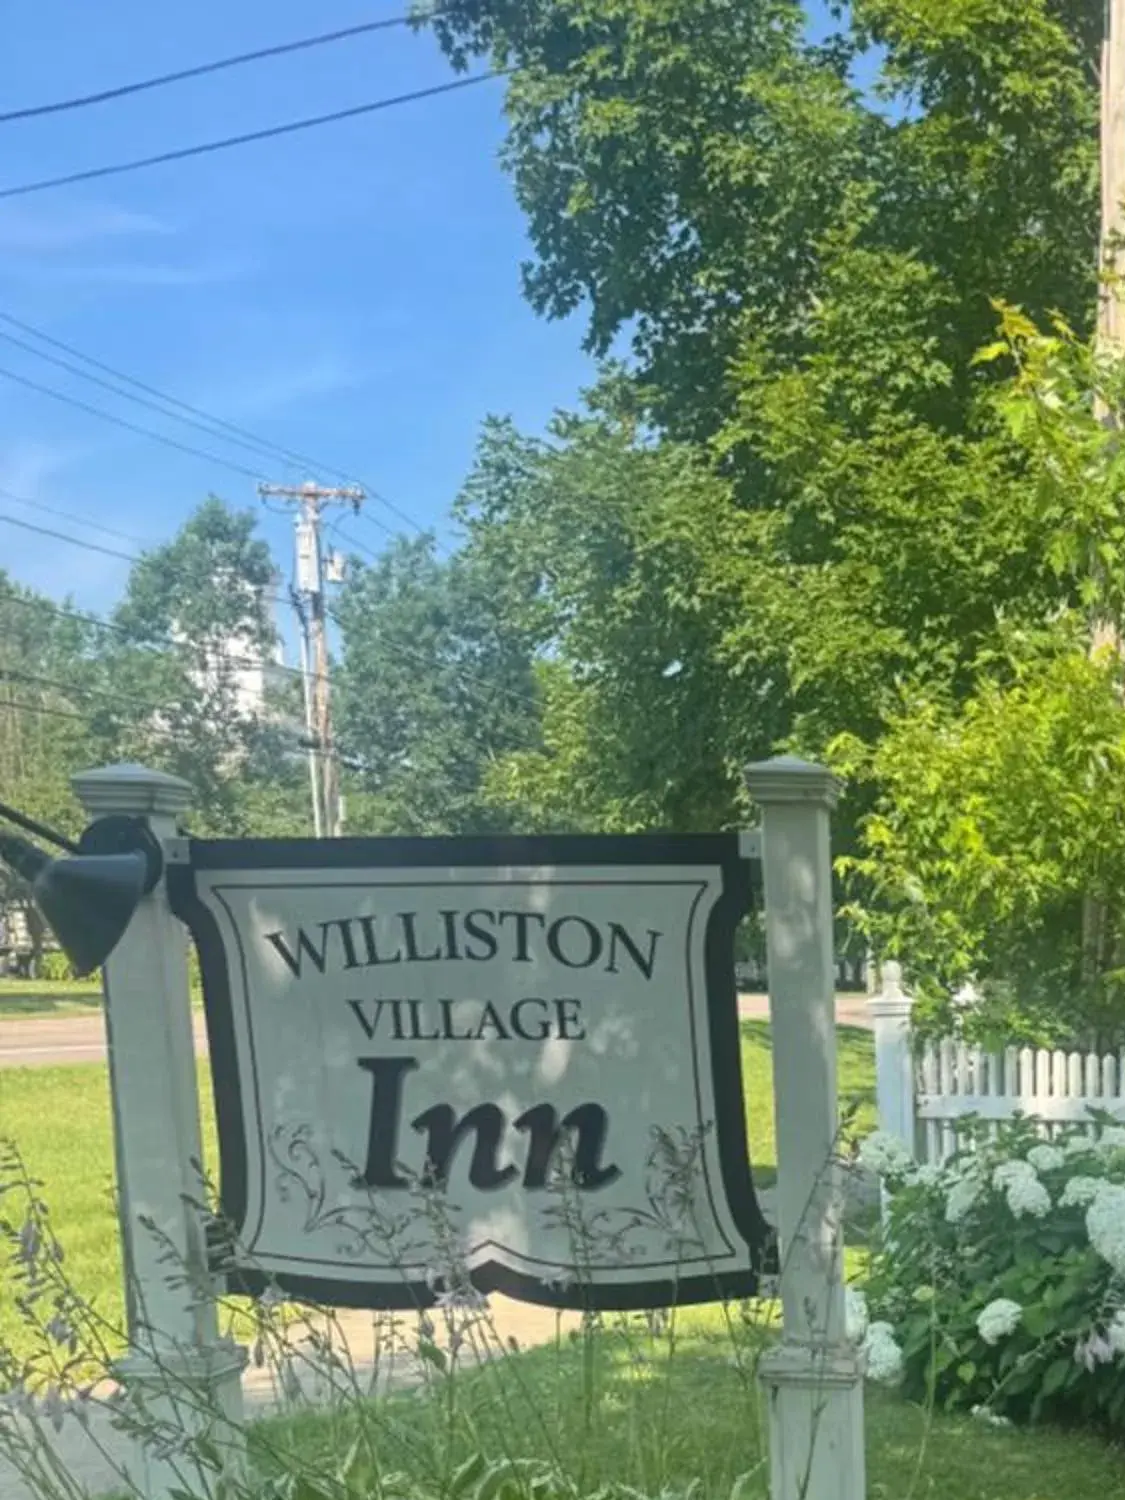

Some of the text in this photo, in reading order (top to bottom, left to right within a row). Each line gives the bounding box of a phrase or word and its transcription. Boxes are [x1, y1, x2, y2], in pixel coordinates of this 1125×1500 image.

[266, 908, 662, 981] WILLISTON
[347, 998, 586, 1040] VILLAGE
[350, 1057, 623, 1191] Inn
